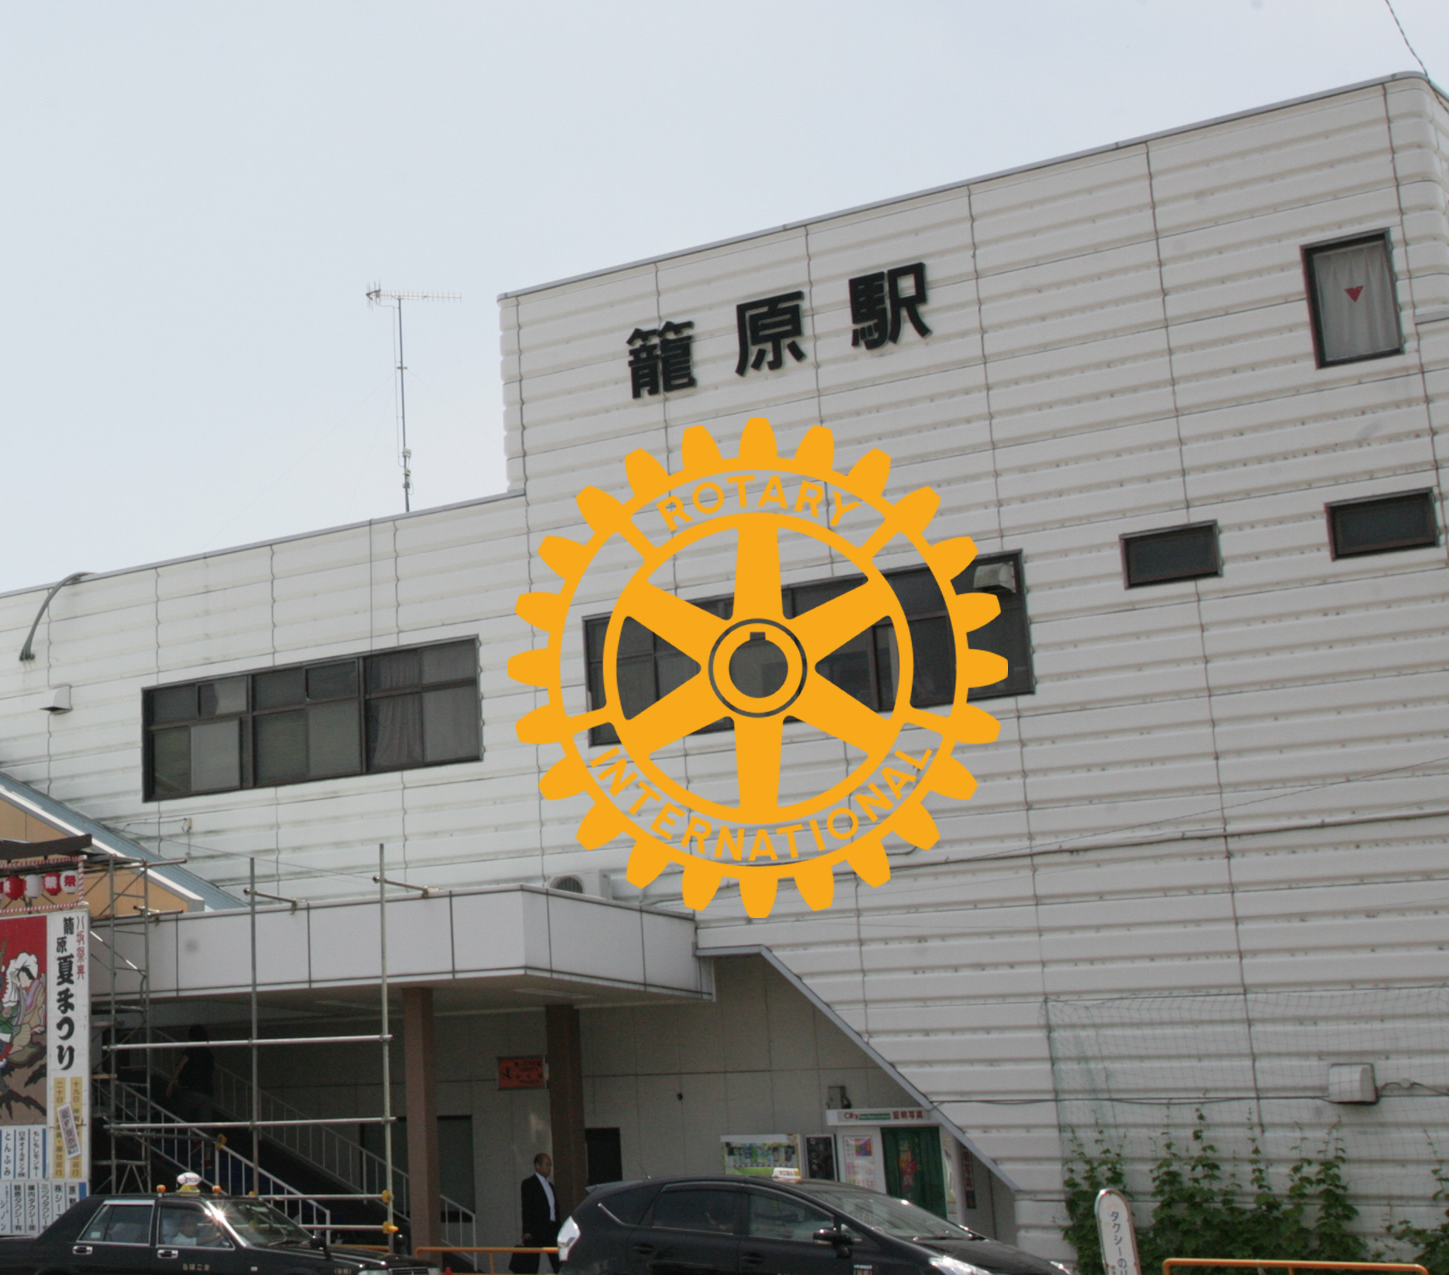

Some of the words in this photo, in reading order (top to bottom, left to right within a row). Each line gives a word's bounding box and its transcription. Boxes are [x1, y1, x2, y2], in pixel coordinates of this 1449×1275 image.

[626, 262, 933, 400] 籠原駅
[45, 876, 57, 889] 祭
[64, 875, 76, 887] 祭
[72, 1081, 80, 1102] 十九日
[892, 1110, 923, 1119] 証明写真
